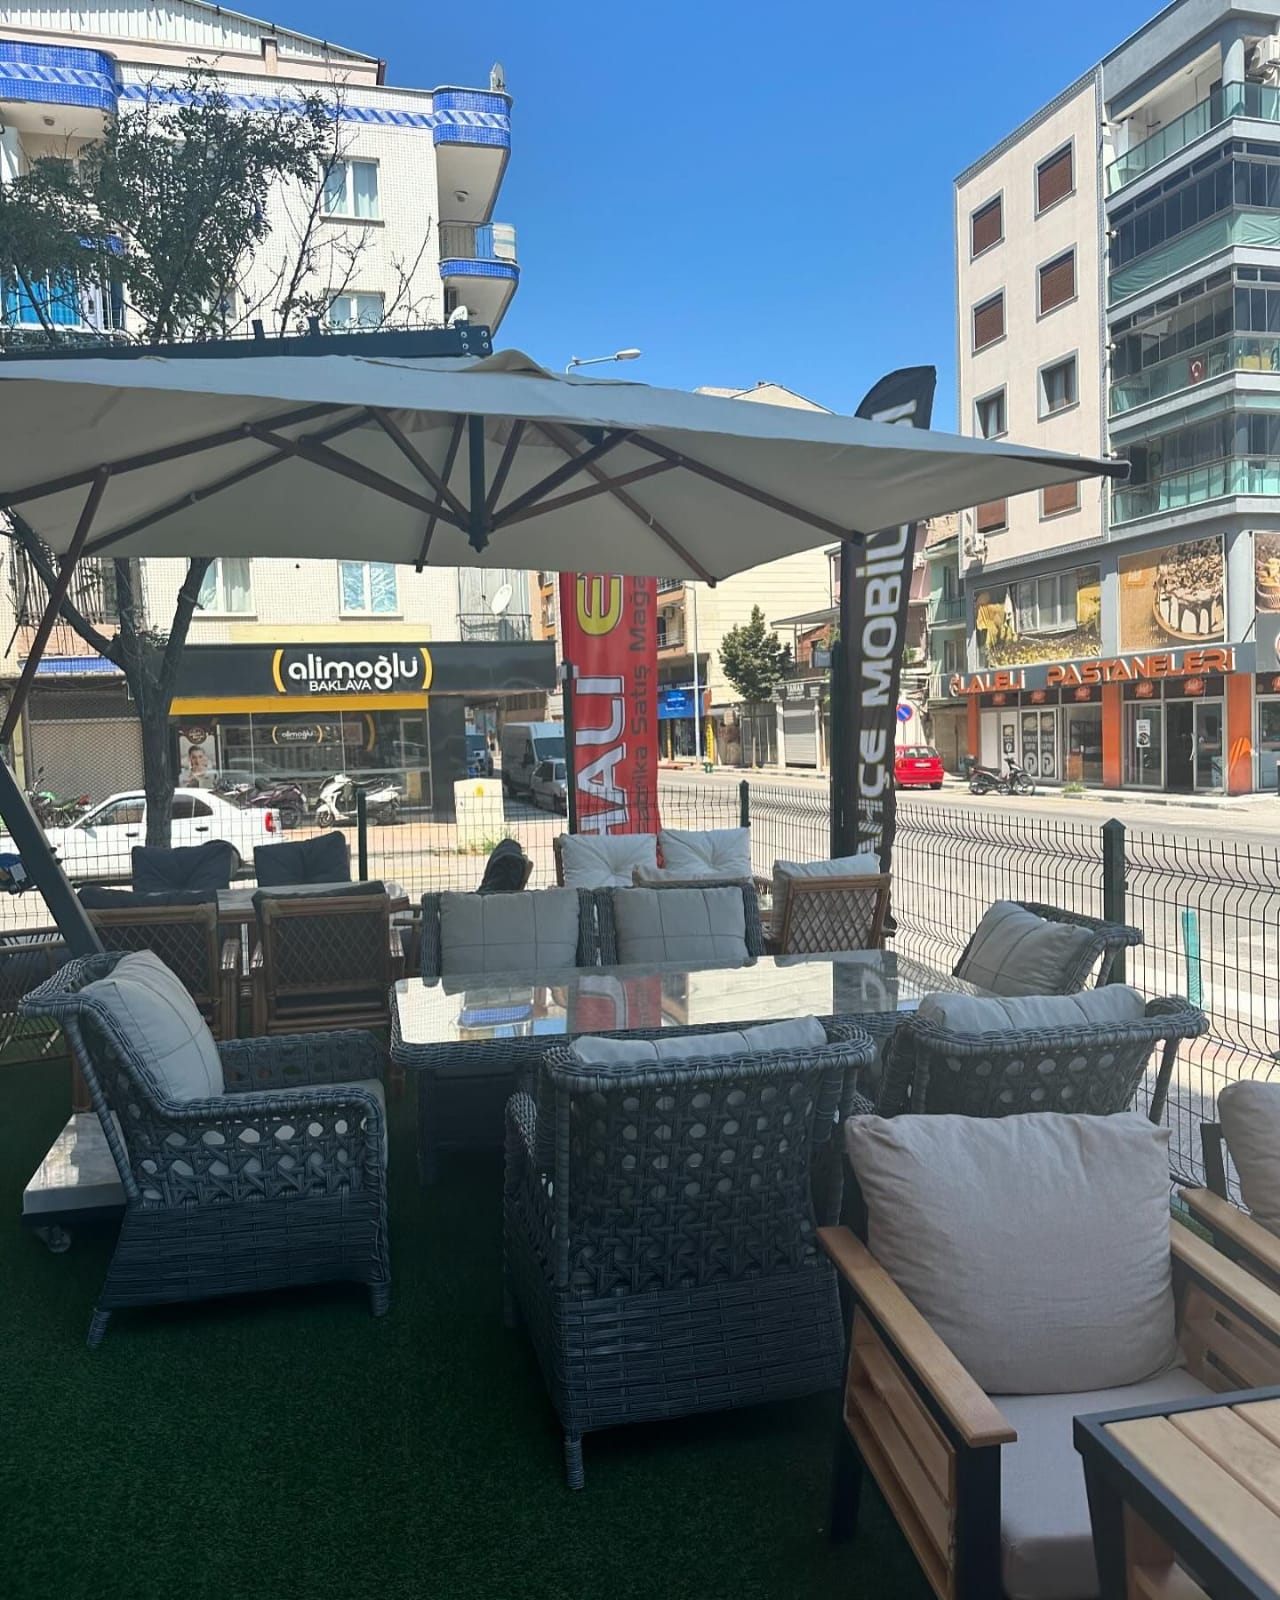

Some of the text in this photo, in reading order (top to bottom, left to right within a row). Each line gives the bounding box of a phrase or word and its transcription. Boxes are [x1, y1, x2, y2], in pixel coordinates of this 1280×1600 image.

[288, 652, 418, 690] alimoğlu
[310, 680, 372, 691] BAKLAVA
[1047, 647, 1236, 687] PASTANELERİ
[631, 665, 651, 735] Satış
